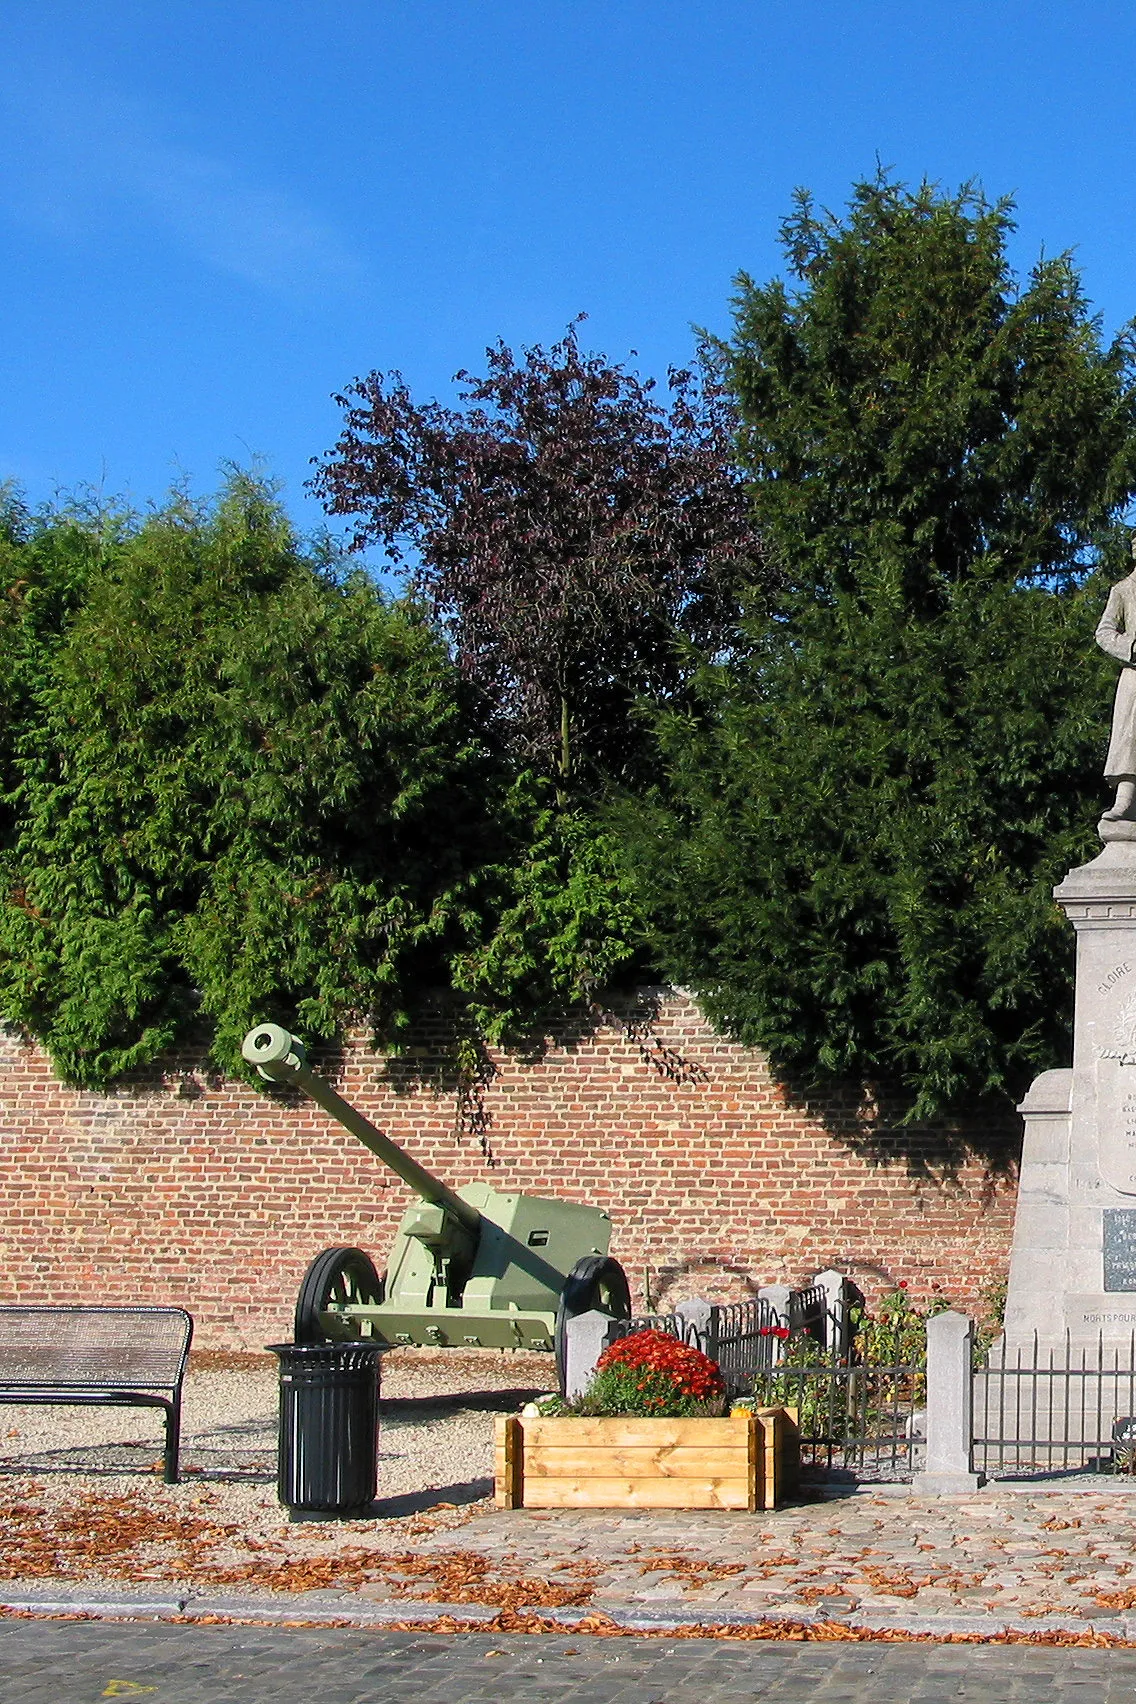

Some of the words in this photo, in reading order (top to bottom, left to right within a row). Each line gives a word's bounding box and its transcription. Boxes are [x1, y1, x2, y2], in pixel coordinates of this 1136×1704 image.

[1097, 961, 1132, 995] GLOIRE
[1083, 1313, 1113, 1322] MORTS
[1113, 1313, 1136, 1322] POUR
